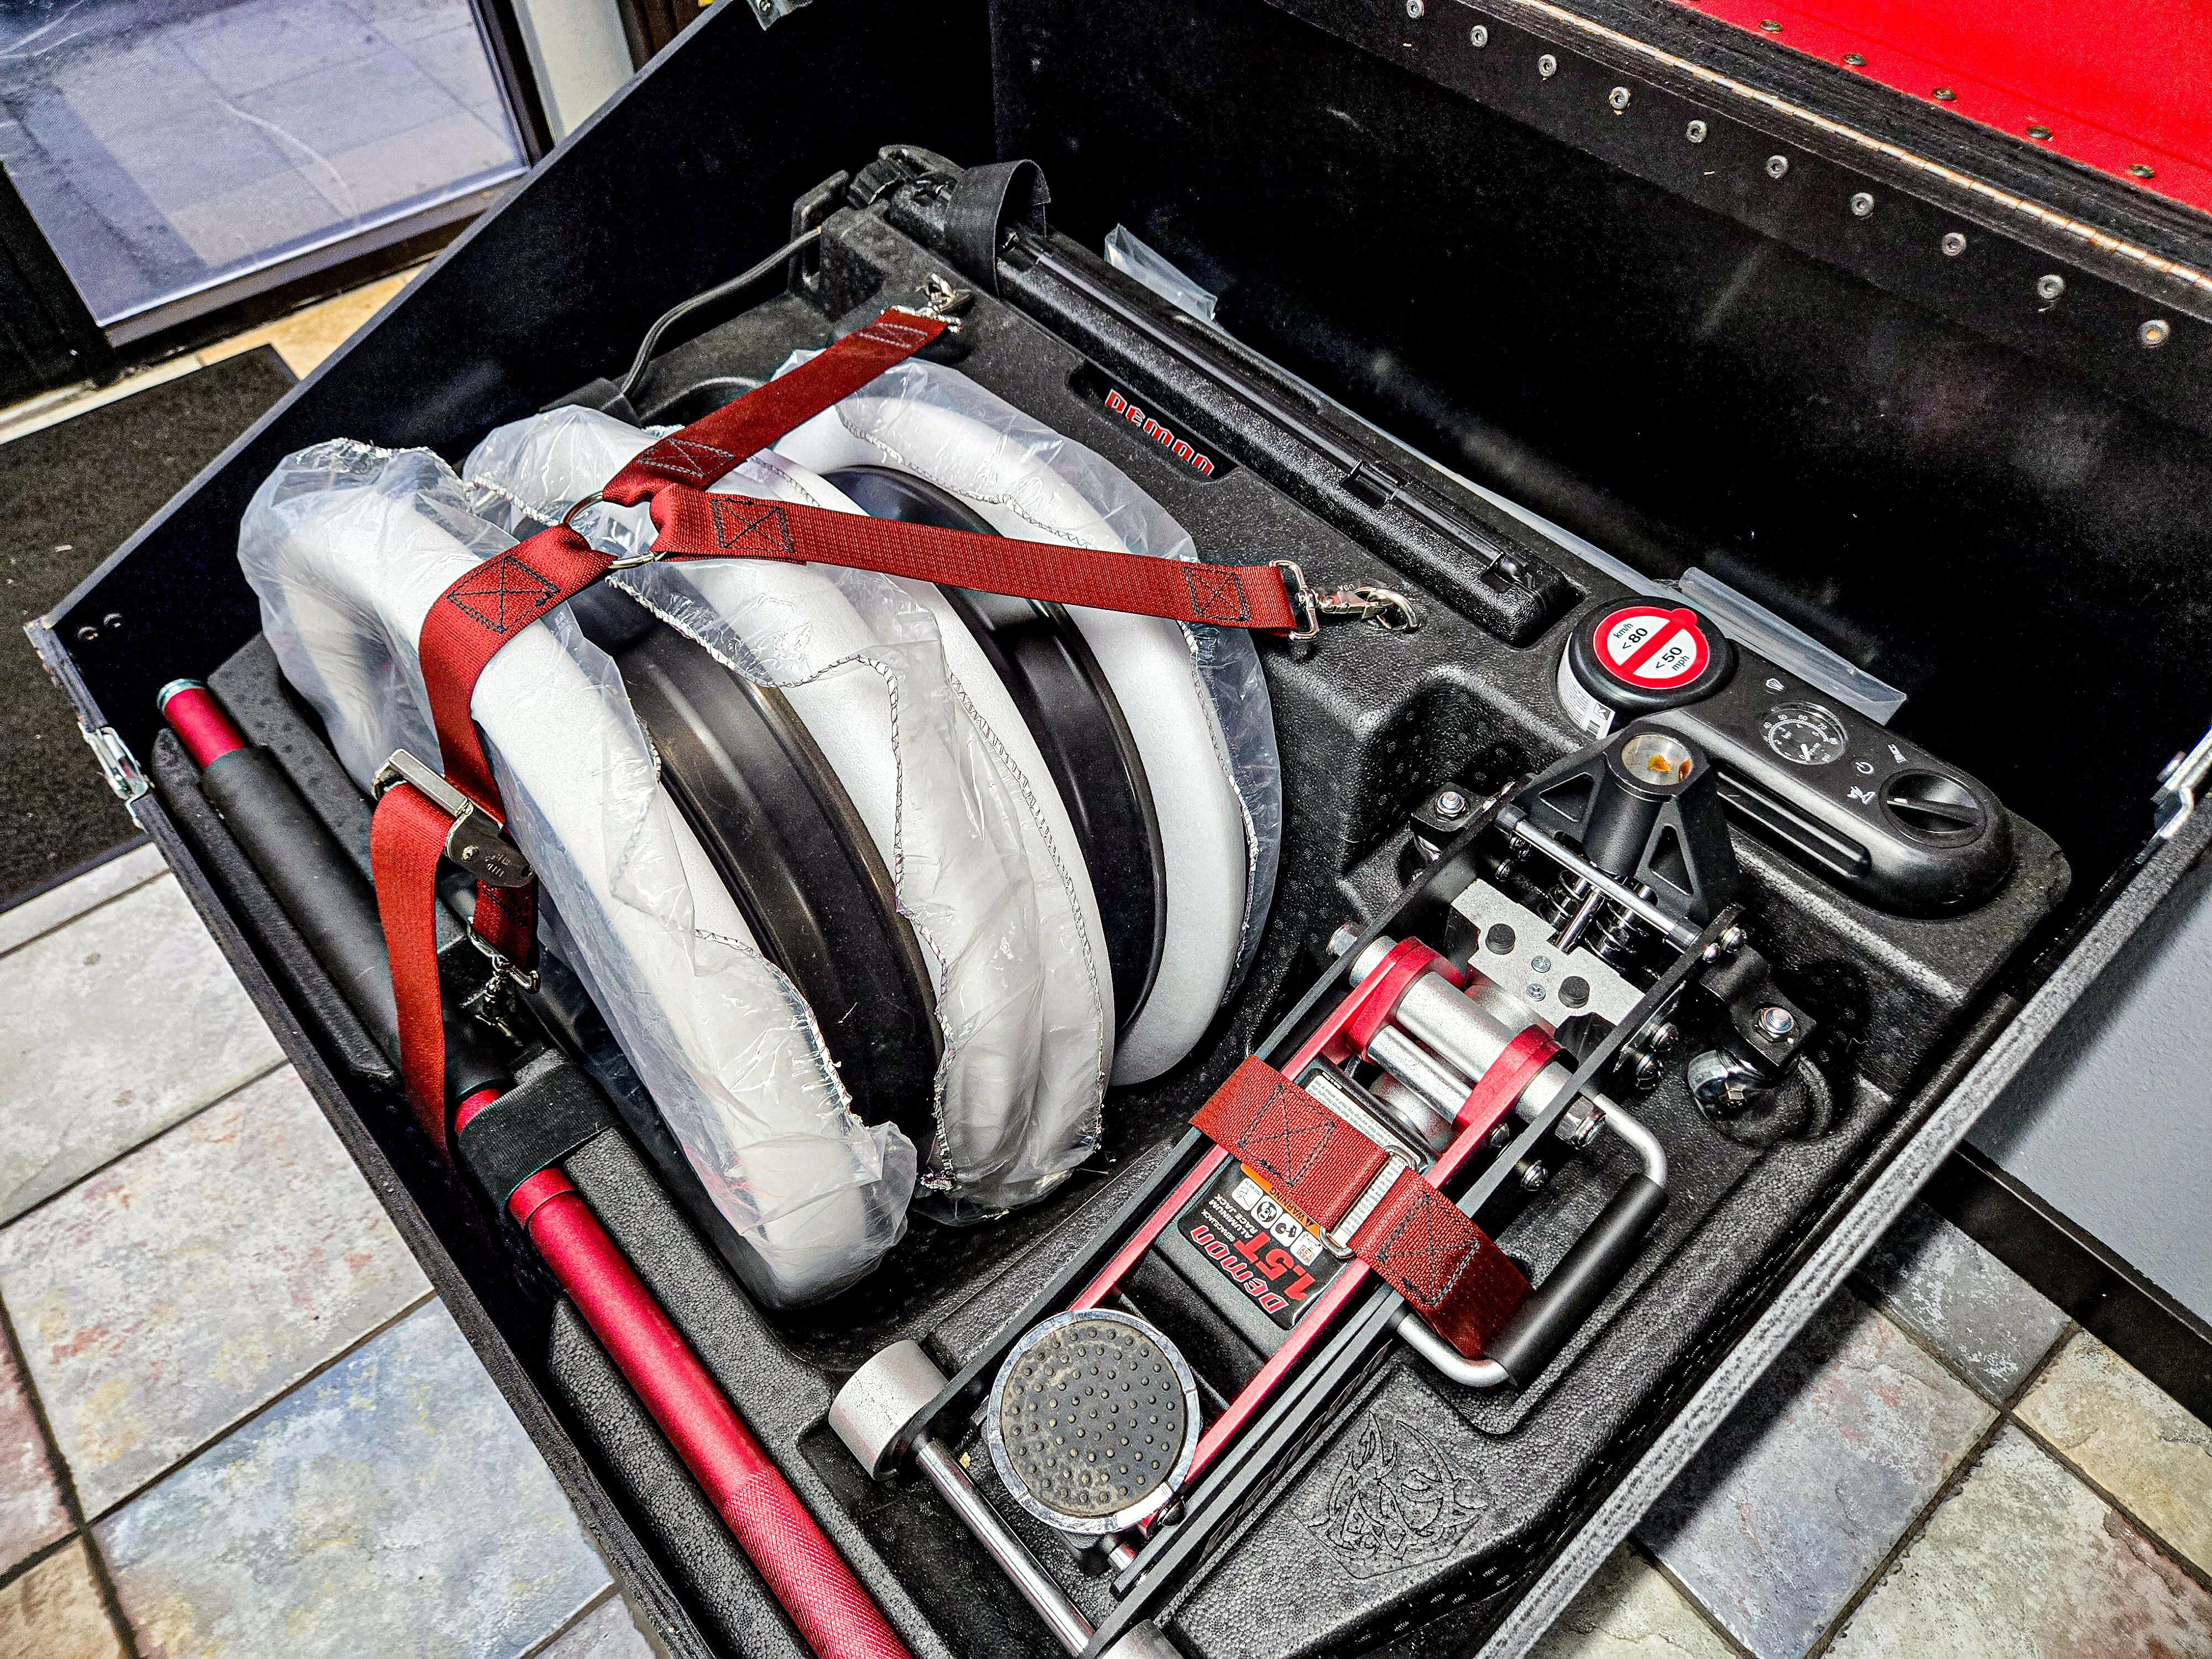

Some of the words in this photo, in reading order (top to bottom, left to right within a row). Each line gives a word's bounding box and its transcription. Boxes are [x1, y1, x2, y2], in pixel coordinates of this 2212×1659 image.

[1105, 389, 1214, 477] DEMON
[1613, 623, 1633, 638] km/h
[1672, 655, 1689, 671] mph
[1213, 1192, 1238, 1215] JACK
[1269, 1186, 1306, 1221] WARNING
[1208, 1199, 1253, 1239] ALUMINUM
[1234, 1212, 1259, 1235] RACE
[1297, 1250, 1311, 1262] MAX
[1301, 1247, 1312, 1258] 1.5T
[1190, 1224, 1290, 1314] DEMON
[1234, 1232, 1316, 1301] 1.5T
